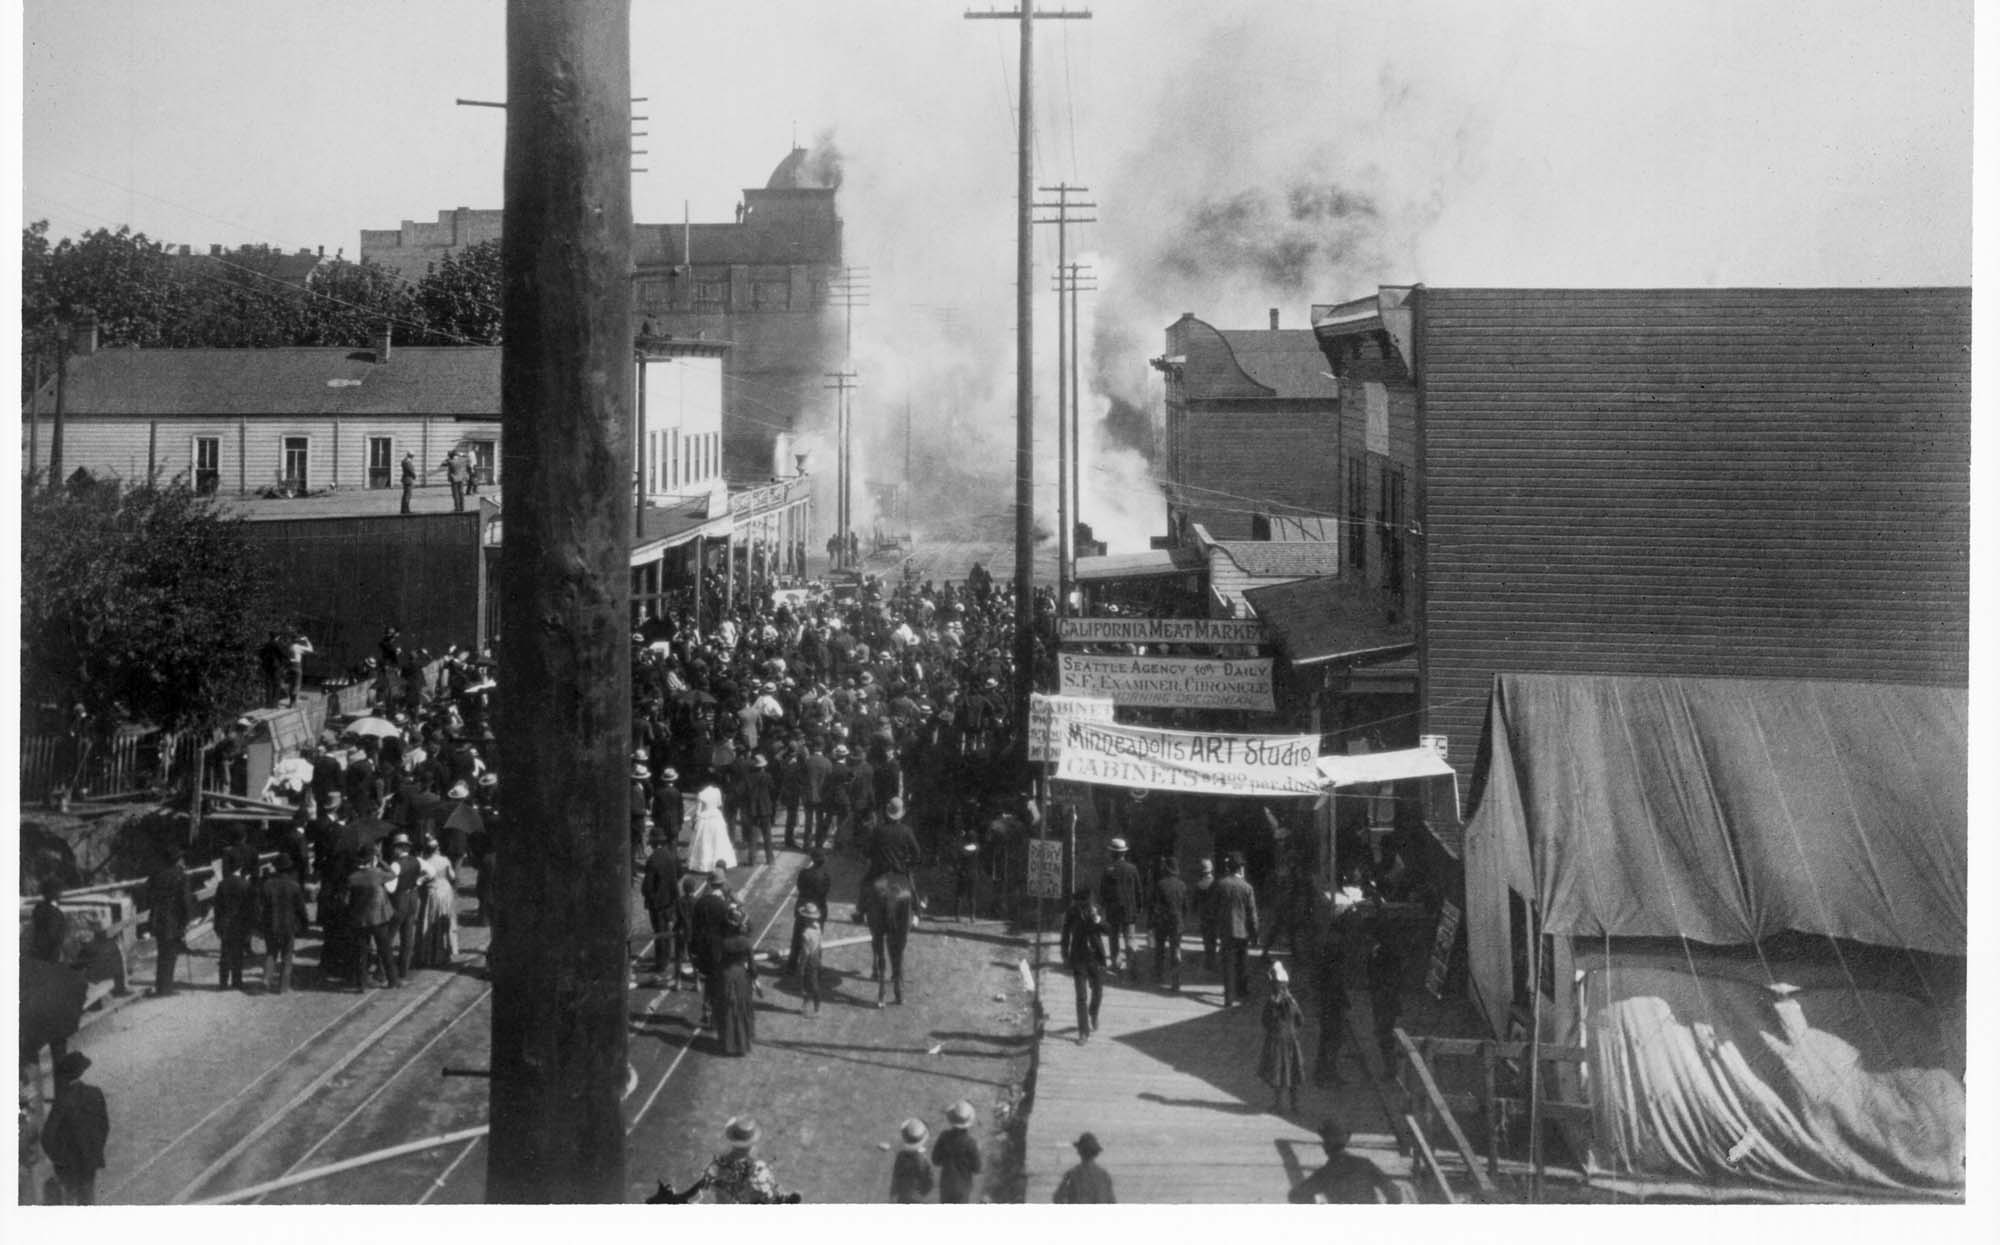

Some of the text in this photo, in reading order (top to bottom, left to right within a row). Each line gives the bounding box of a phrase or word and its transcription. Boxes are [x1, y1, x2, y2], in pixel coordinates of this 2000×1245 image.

[1149, 620, 1193, 638] MEAT
[1064, 656, 1128, 673] SEATTLE
[1131, 660, 1186, 674] AGENCY
[1224, 662, 1267, 677] DAILY
[1189, 735, 1239, 763] ART
[1244, 737, 1312, 767] Studio
